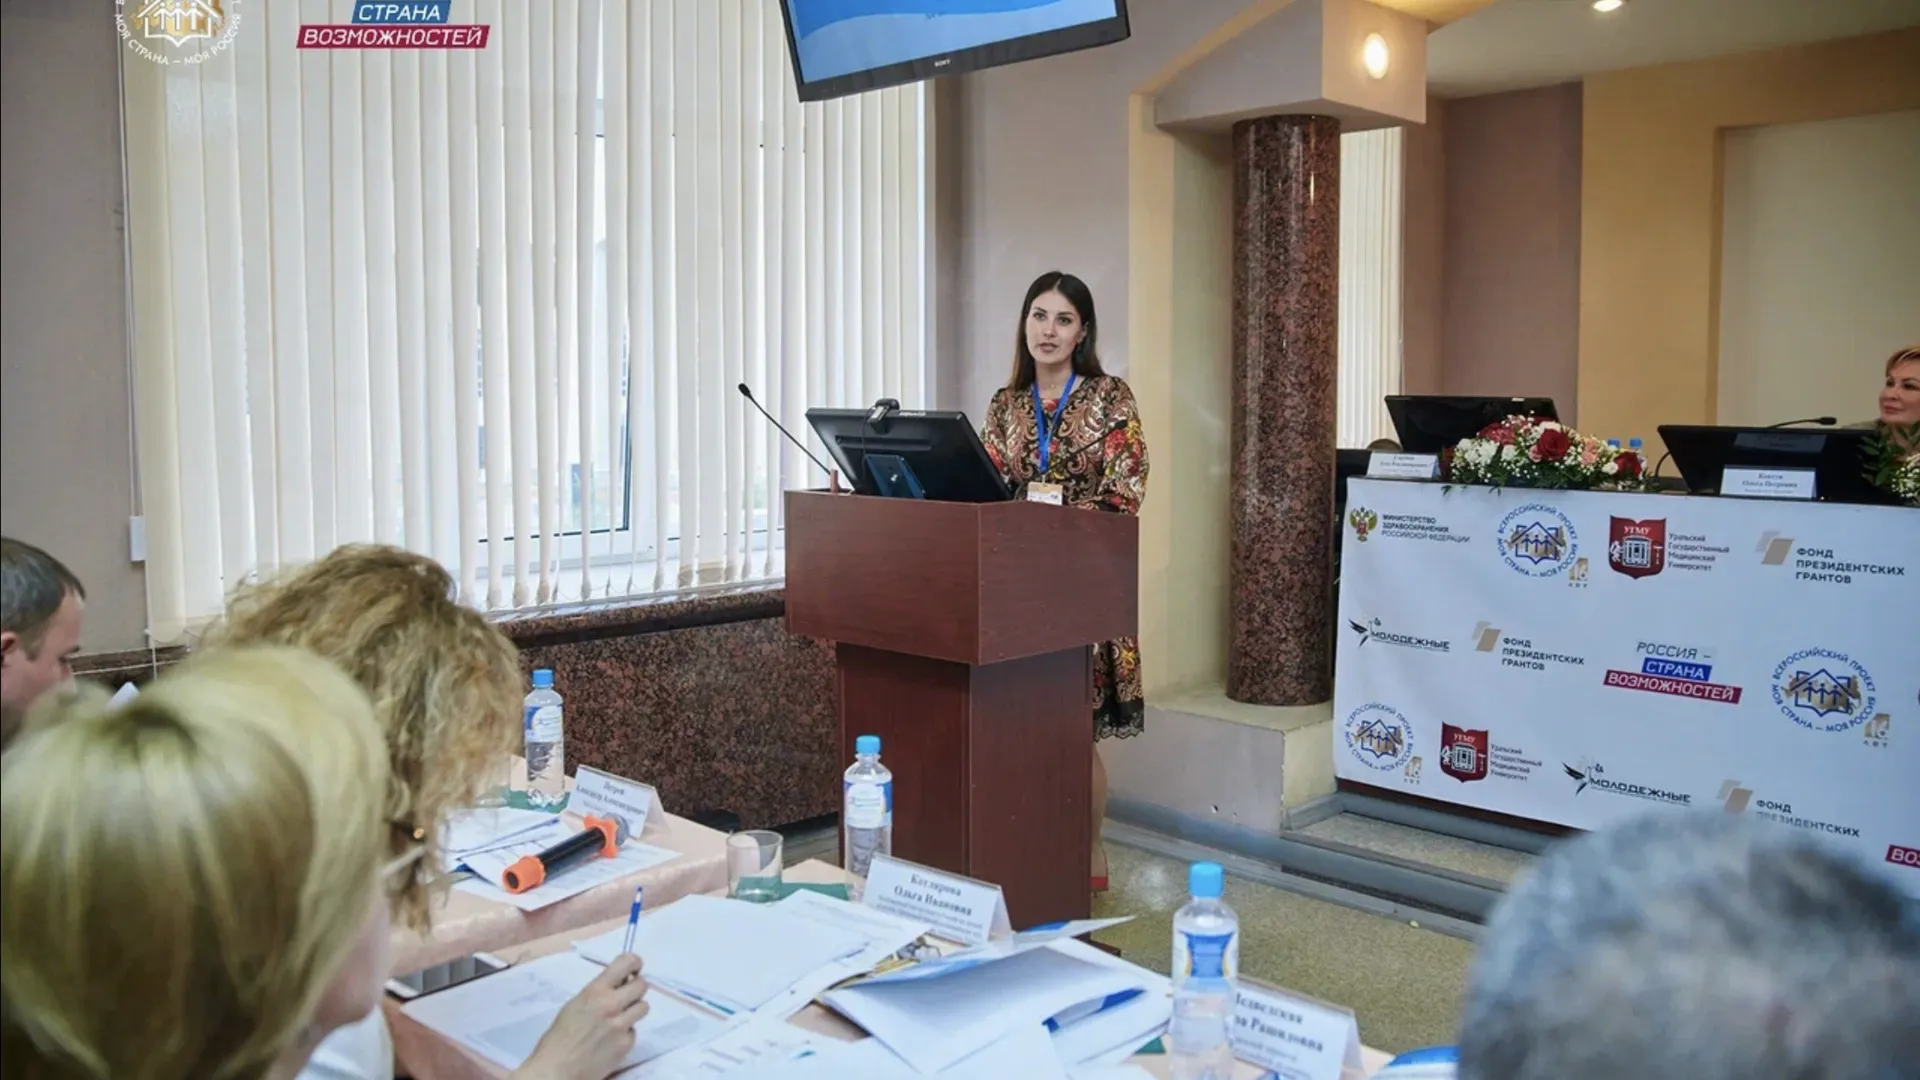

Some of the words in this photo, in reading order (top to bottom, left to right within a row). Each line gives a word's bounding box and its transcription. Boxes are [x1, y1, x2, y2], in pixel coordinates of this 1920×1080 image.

[1382, 514, 1437, 524] МИНИСТЕРСТВО
[1497, 503, 1557, 534] ВСЕРОССИЙСКИЙ
[1557, 512, 1578, 539] ПРОЕКТ
[1382, 522, 1449, 532] ЗДРАВООХРАНЕНИЯ
[1624, 525, 1651, 535] УГМУ
[1381, 529, 1427, 540] РОССИЙСКОЙ
[1429, 534, 1470, 543] ФЕДЕРАЦИИ
[1669, 533, 1706, 542] Уральский
[1668, 542, 1730, 553] Государственный
[1797, 547, 1834, 559] ФОНД
[1504, 556, 1530, 576] СТРАНА
[1558, 543, 1578, 572] РОССИЯ
[1668, 551, 1716, 562] Медицинский
[1668, 560, 1712, 571] Университет
[1796, 559, 1905, 576] ПРЕЗИДЕНТСКИХ
[1796, 571, 1851, 584] ГРАНТОВ
[1371, 631, 1450, 649] МОЛОДЕЖНЫЕ
[1503, 637, 1532, 649] ФОНД
[1502, 647, 1585, 665] ПРЕЗИДЕНТСКИХ
[1636, 641, 1698, 660] РОССИЯ
[1502, 658, 1545, 671] ГРАНТОВ
[1645, 660, 1705, 679] СТРАНА
[1772, 647, 1849, 680] ВСЕРОССИЙСКИЙ
[1849, 660, 1876, 692] ПРОЕКТ
[1608, 672, 1735, 700] ВОЗМОЖНОСТЕЙ
[1772, 684, 1783, 705] МОЯ
[1781, 706, 1813, 729] СТРАНА
[1826, 721, 1849, 732] МОЯ
[1849, 696, 1876, 728] РОССИЯ
[1396, 713, 1414, 740] ПРОЕКТ
[1453, 733, 1476, 743] УГМУ
[1590, 778, 1691, 803] МОЛОДЕЖНЫЕ
[1756, 799, 1792, 814] ФОНД
